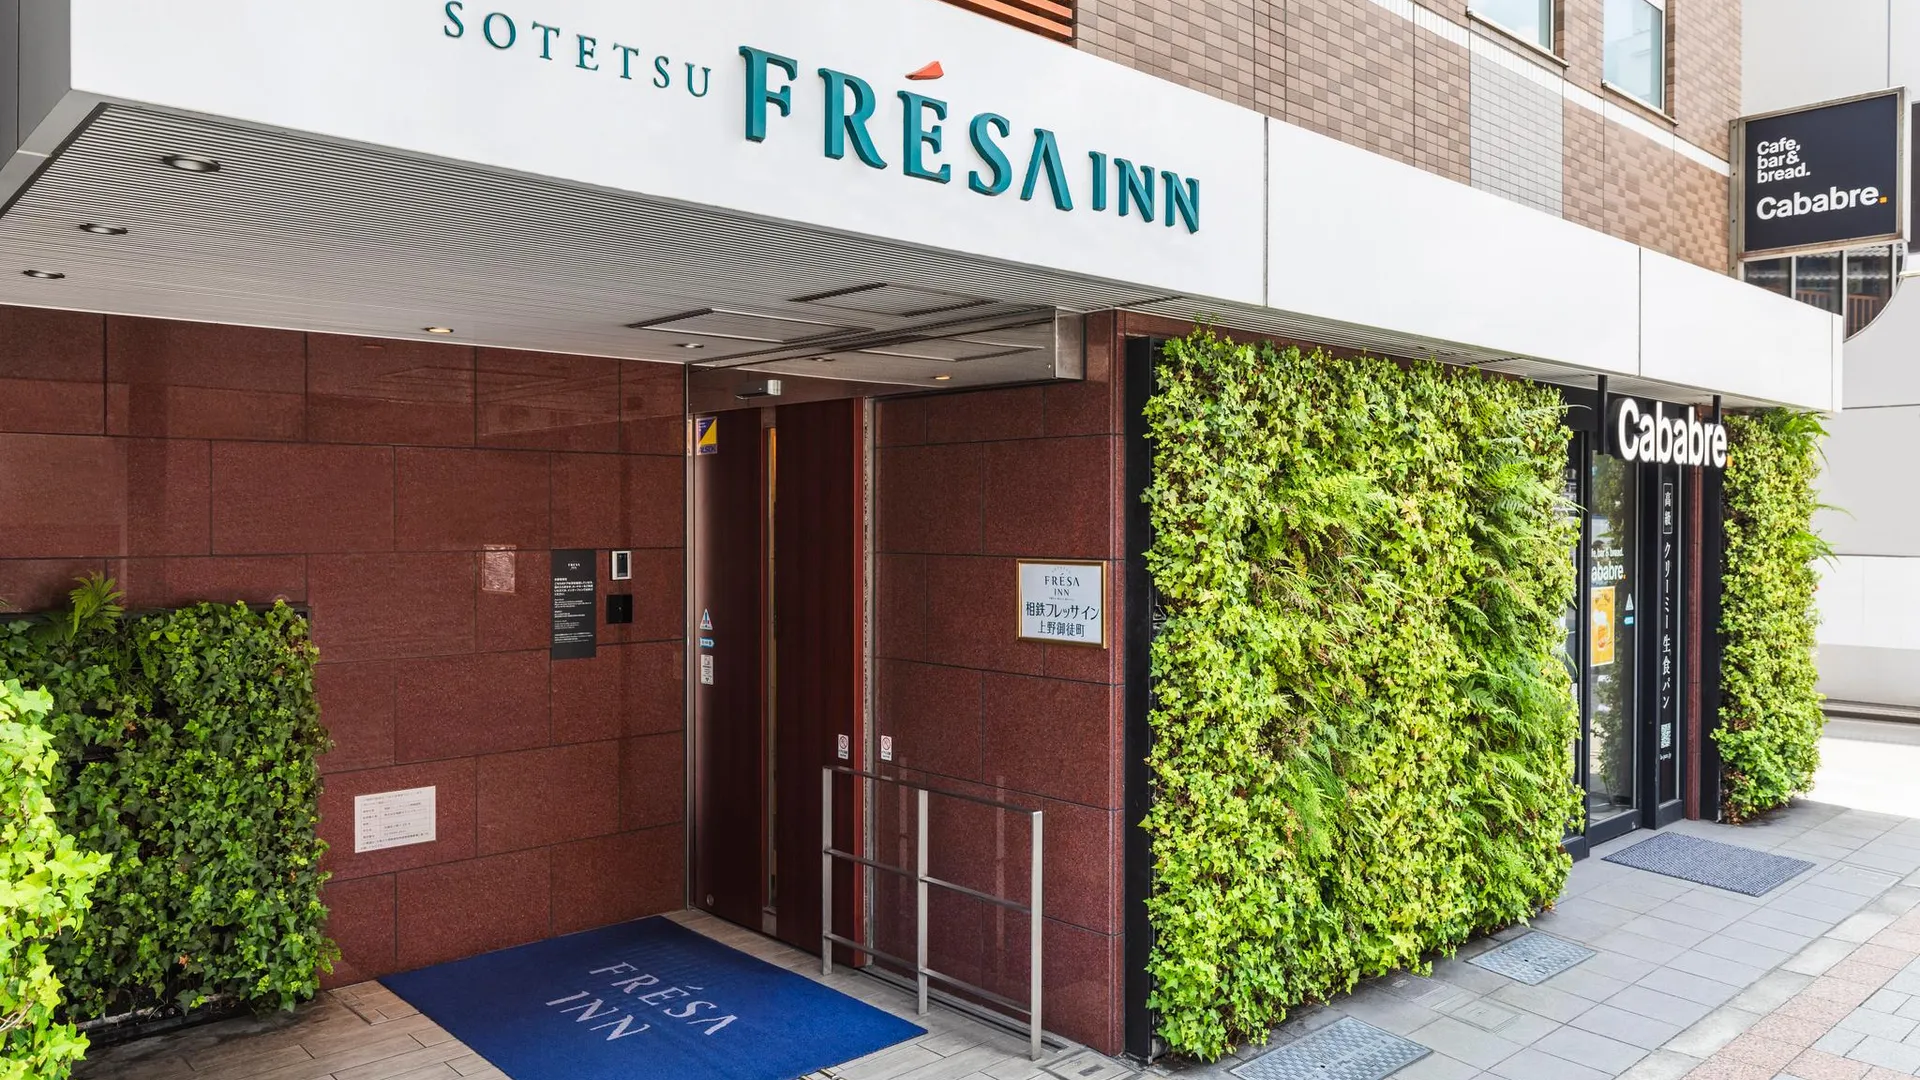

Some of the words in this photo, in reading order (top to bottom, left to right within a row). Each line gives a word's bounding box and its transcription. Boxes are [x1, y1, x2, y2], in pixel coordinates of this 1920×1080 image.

[444, 0, 711, 97] SOTETSU
[739, 46, 1073, 210] FRÉSA
[1088, 150, 1200, 234] INN
[1757, 137, 1801, 155] Cafe,
[1757, 154, 1786, 169] bar
[1786, 150, 1800, 164] &
[1757, 163, 1811, 183] bread.
[1756, 186, 1888, 220] Cababre.
[1618, 398, 1733, 468] Cababre.
[1044, 572, 1080, 587] FRÉSA
[1591, 561, 1627, 581] ababre.
[1053, 588, 1070, 597] INN
[1026, 601, 1099, 620] 相鉄フレッサイン
[1038, 620, 1085, 637] 上野御徒町
[589, 961, 738, 1036] FRÉSA
[545, 990, 650, 1041] INN
